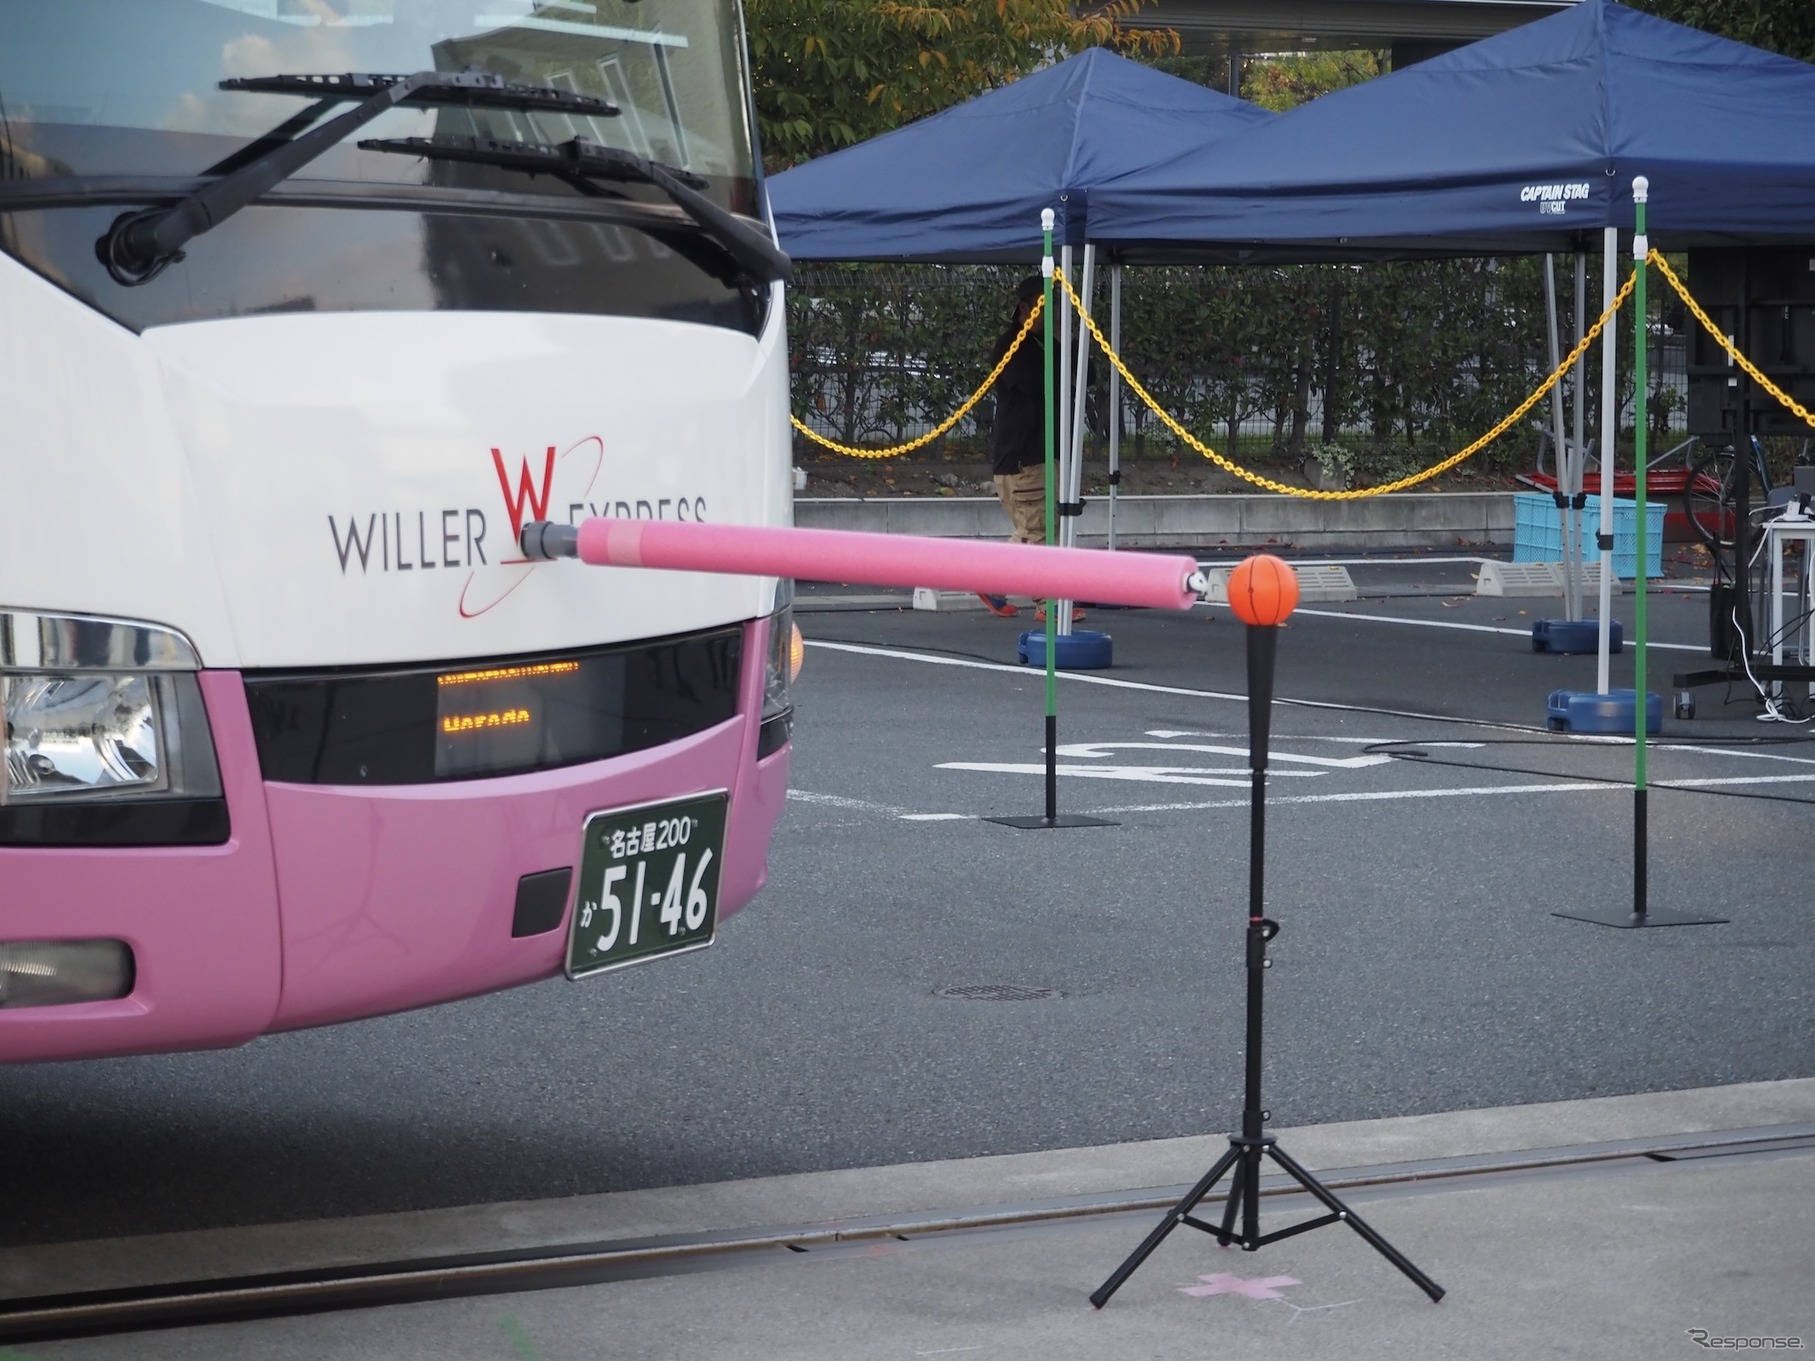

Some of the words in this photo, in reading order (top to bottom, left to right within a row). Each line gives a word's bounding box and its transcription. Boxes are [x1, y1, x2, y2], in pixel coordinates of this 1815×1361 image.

[1521, 184, 1563, 201] CAPTAIN
[1563, 183, 1589, 199] STAG
[328, 508, 488, 576] WILLER
[597, 848, 713, 951] 51-46
